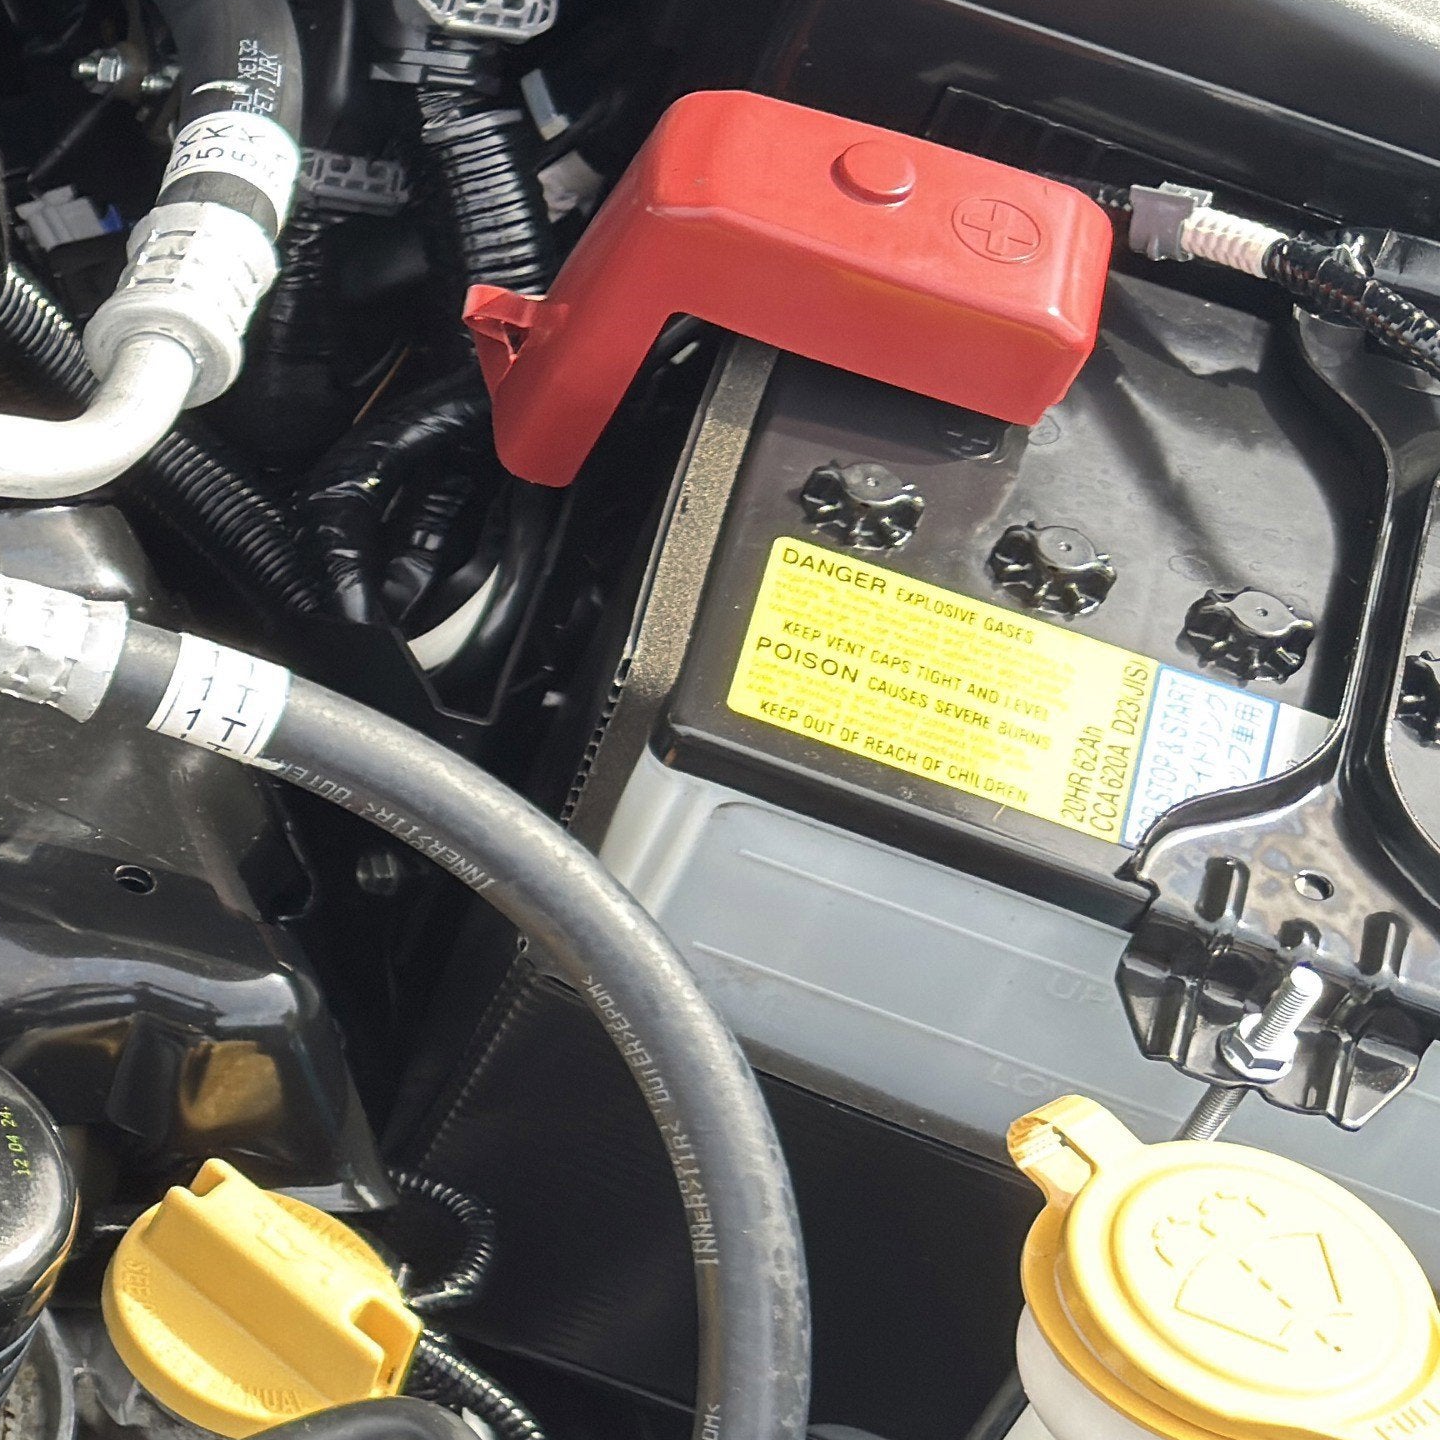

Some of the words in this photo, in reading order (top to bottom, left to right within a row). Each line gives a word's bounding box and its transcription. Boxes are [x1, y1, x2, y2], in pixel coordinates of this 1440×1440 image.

[782, 547, 887, 594] DANGER
[896, 587, 977, 626] EXPLOSIVE
[983, 616, 1035, 645] GASES
[755, 636, 859, 683] POISON
[867, 676, 929, 709] CAUSES
[934, 699, 993, 730] SEVERE
[782, 620, 821, 641] KEEP
[826, 634, 866, 656] VENT
[870, 650, 912, 675] CAPS
[916, 665, 962, 691] TIGHT
[967, 683, 1000, 704] AND
[1159, 676, 1197, 738] START
[759, 700, 799, 722] KEEP
[802, 715, 835, 736] OUT
[839, 727, 860, 743] OF
[863, 736, 918, 765] REACH
[921, 755, 944, 772] OF
[946, 764, 1028, 804] CHILDREN
[1100, 743, 1131, 789] 620A
[1145, 754, 1179, 804] STOP
[1060, 771, 1089, 823] 20HR
[1088, 790, 1121, 833] CCA
